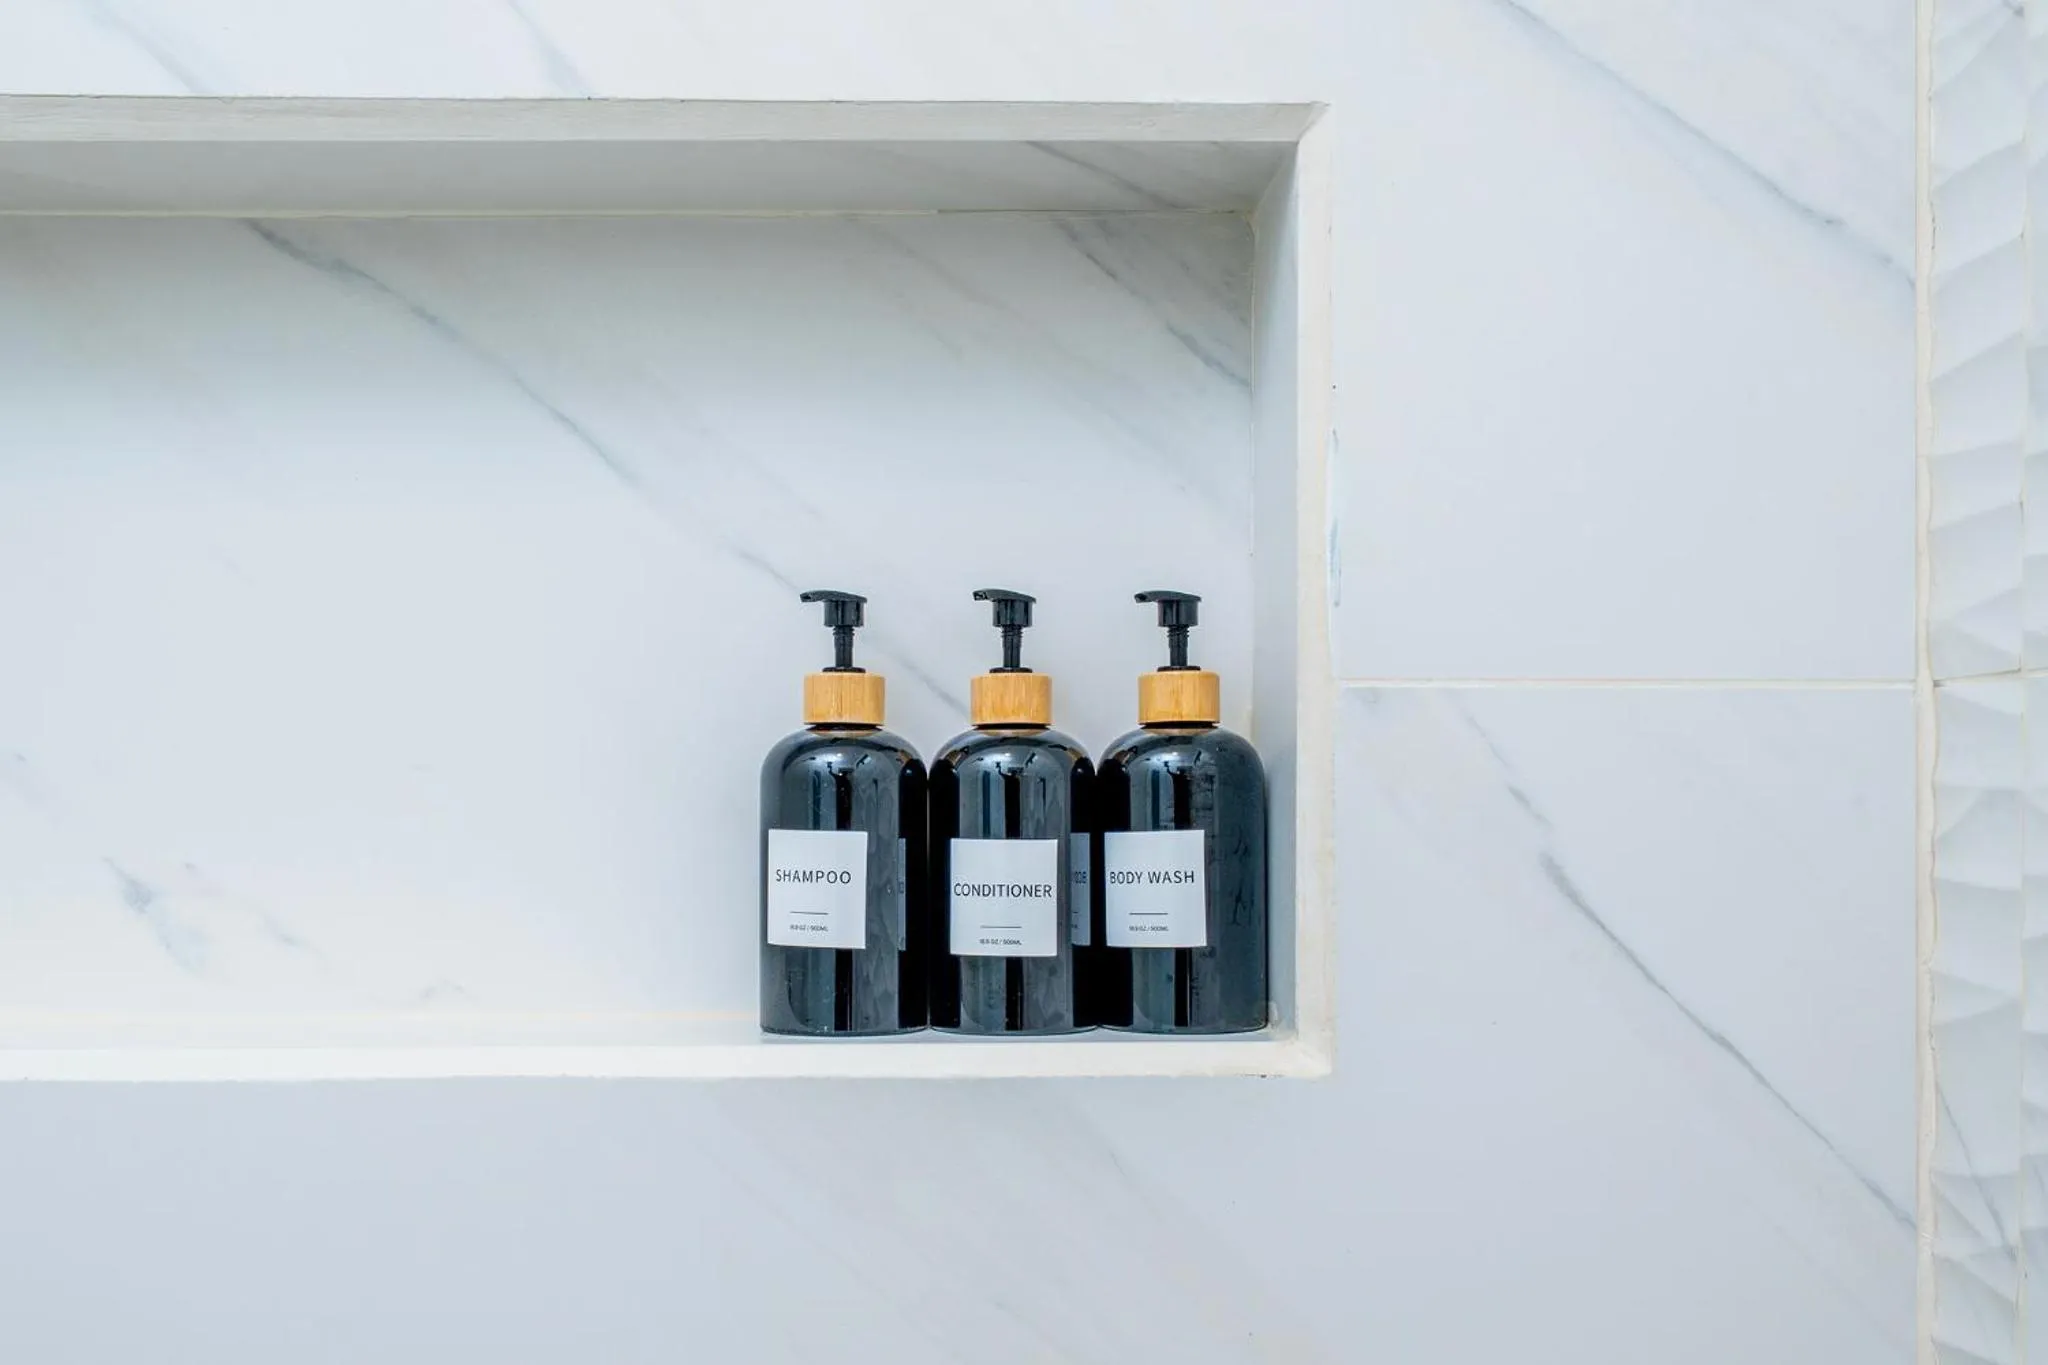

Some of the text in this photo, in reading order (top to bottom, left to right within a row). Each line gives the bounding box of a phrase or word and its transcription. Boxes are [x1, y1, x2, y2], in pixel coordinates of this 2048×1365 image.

[775, 868, 852, 884] SHAMPOO
[1109, 870, 1195, 884] BODY WASH
[953, 882, 1053, 898] CONDITIONER
